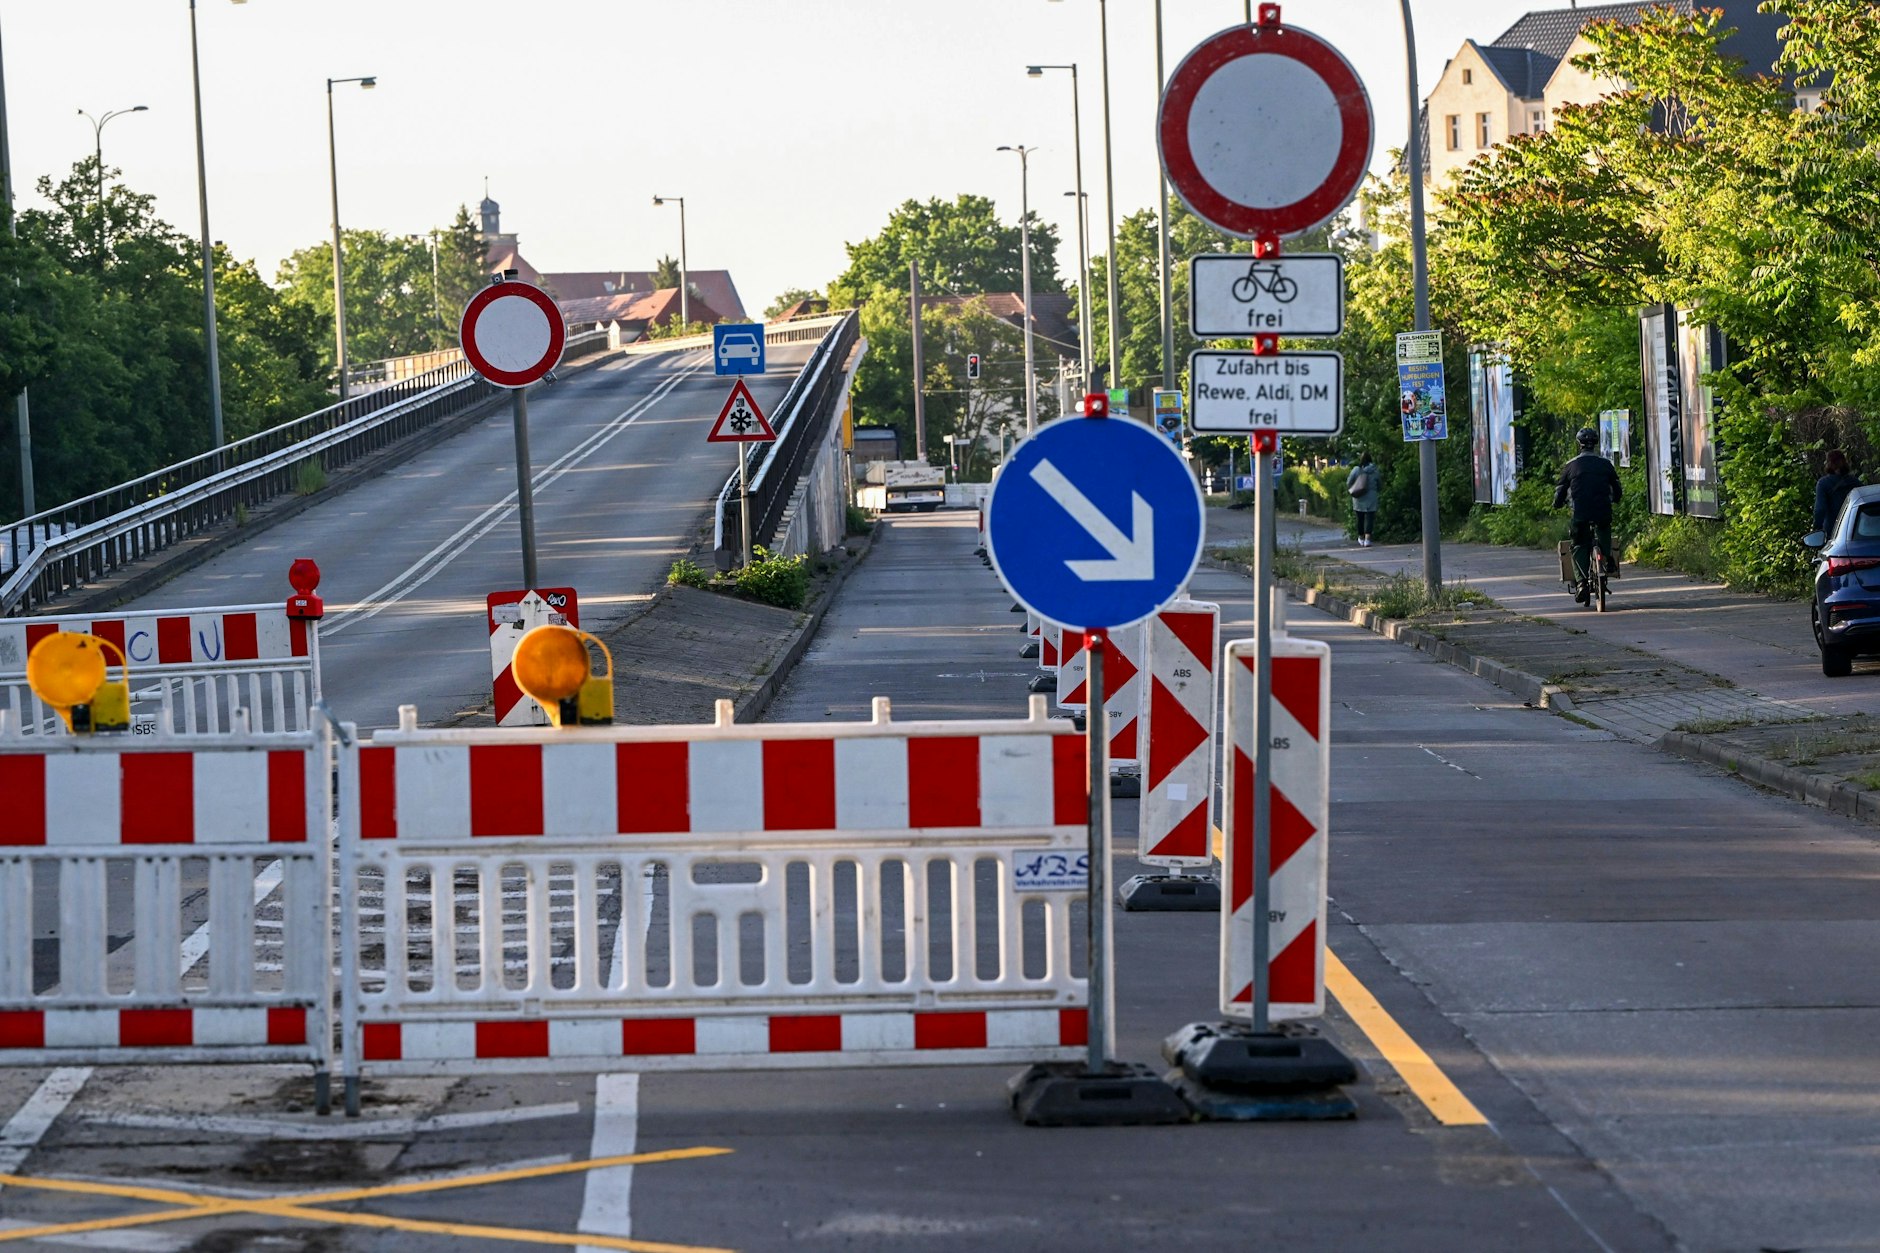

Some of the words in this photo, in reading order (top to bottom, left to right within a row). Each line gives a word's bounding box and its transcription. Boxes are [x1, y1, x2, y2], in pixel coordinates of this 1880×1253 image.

[1247, 309, 1283, 327] frei
[1216, 358, 1279, 375] Zufahrt
[1285, 360, 1310, 376] bis
[1197, 383, 1250, 401] Rewe,
[1256, 384, 1294, 402] Aldi,
[1300, 384, 1328, 400] DM
[1248, 408, 1278, 425] frei
[1172, 668, 1192, 678] ABS
